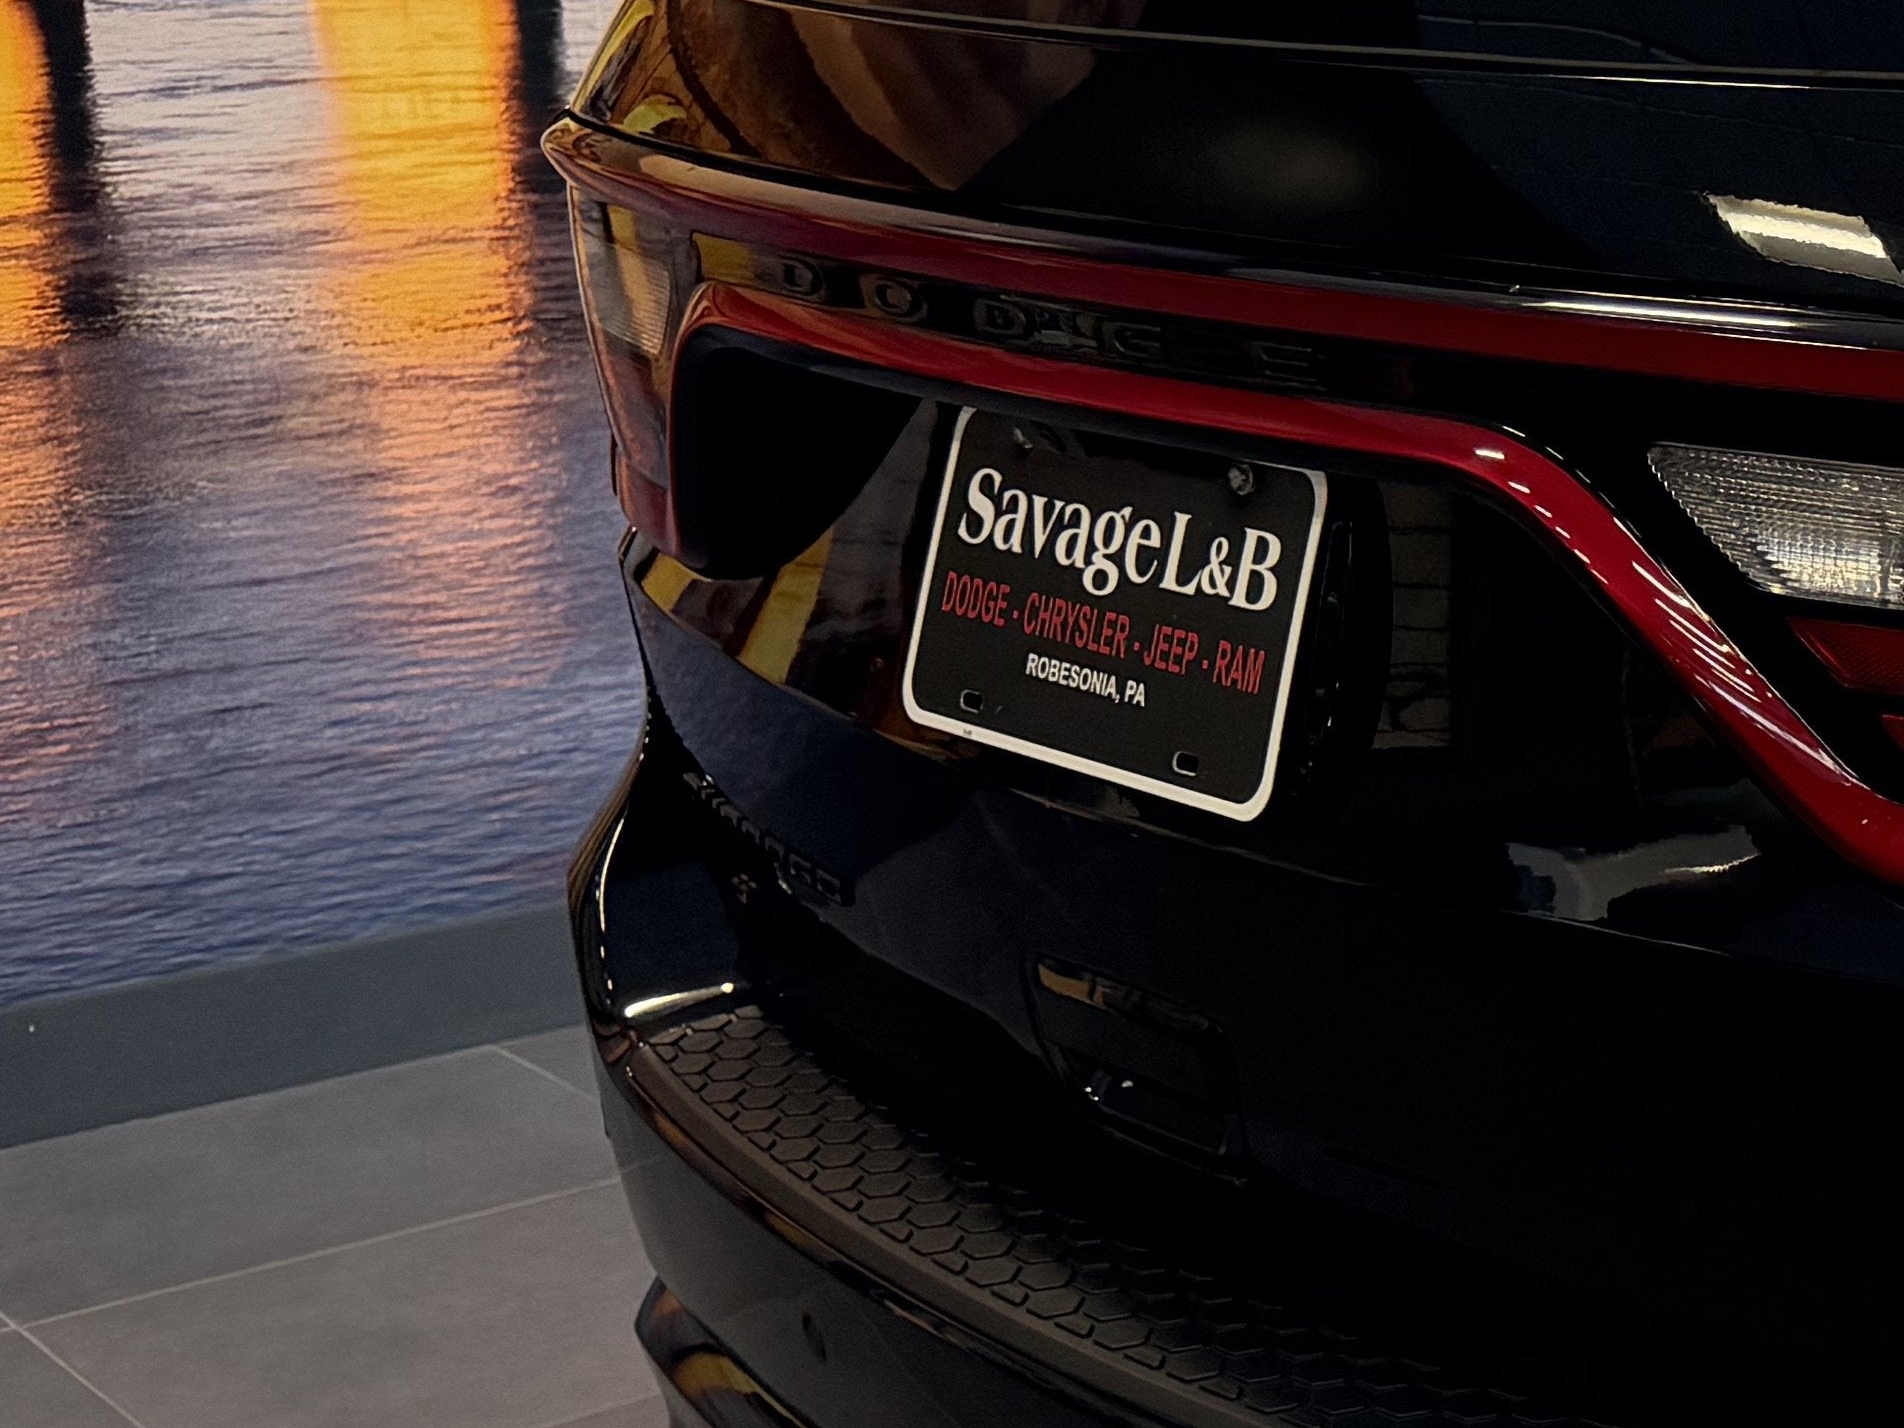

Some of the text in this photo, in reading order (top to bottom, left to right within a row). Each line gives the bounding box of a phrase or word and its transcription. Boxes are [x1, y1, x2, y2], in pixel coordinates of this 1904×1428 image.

[777, 252, 1328, 393] DODGE
[941, 569, 1267, 695] DODGE CHRYSLER JEEP RAM
[1025, 652, 1146, 708] ROBESONIA, PA
